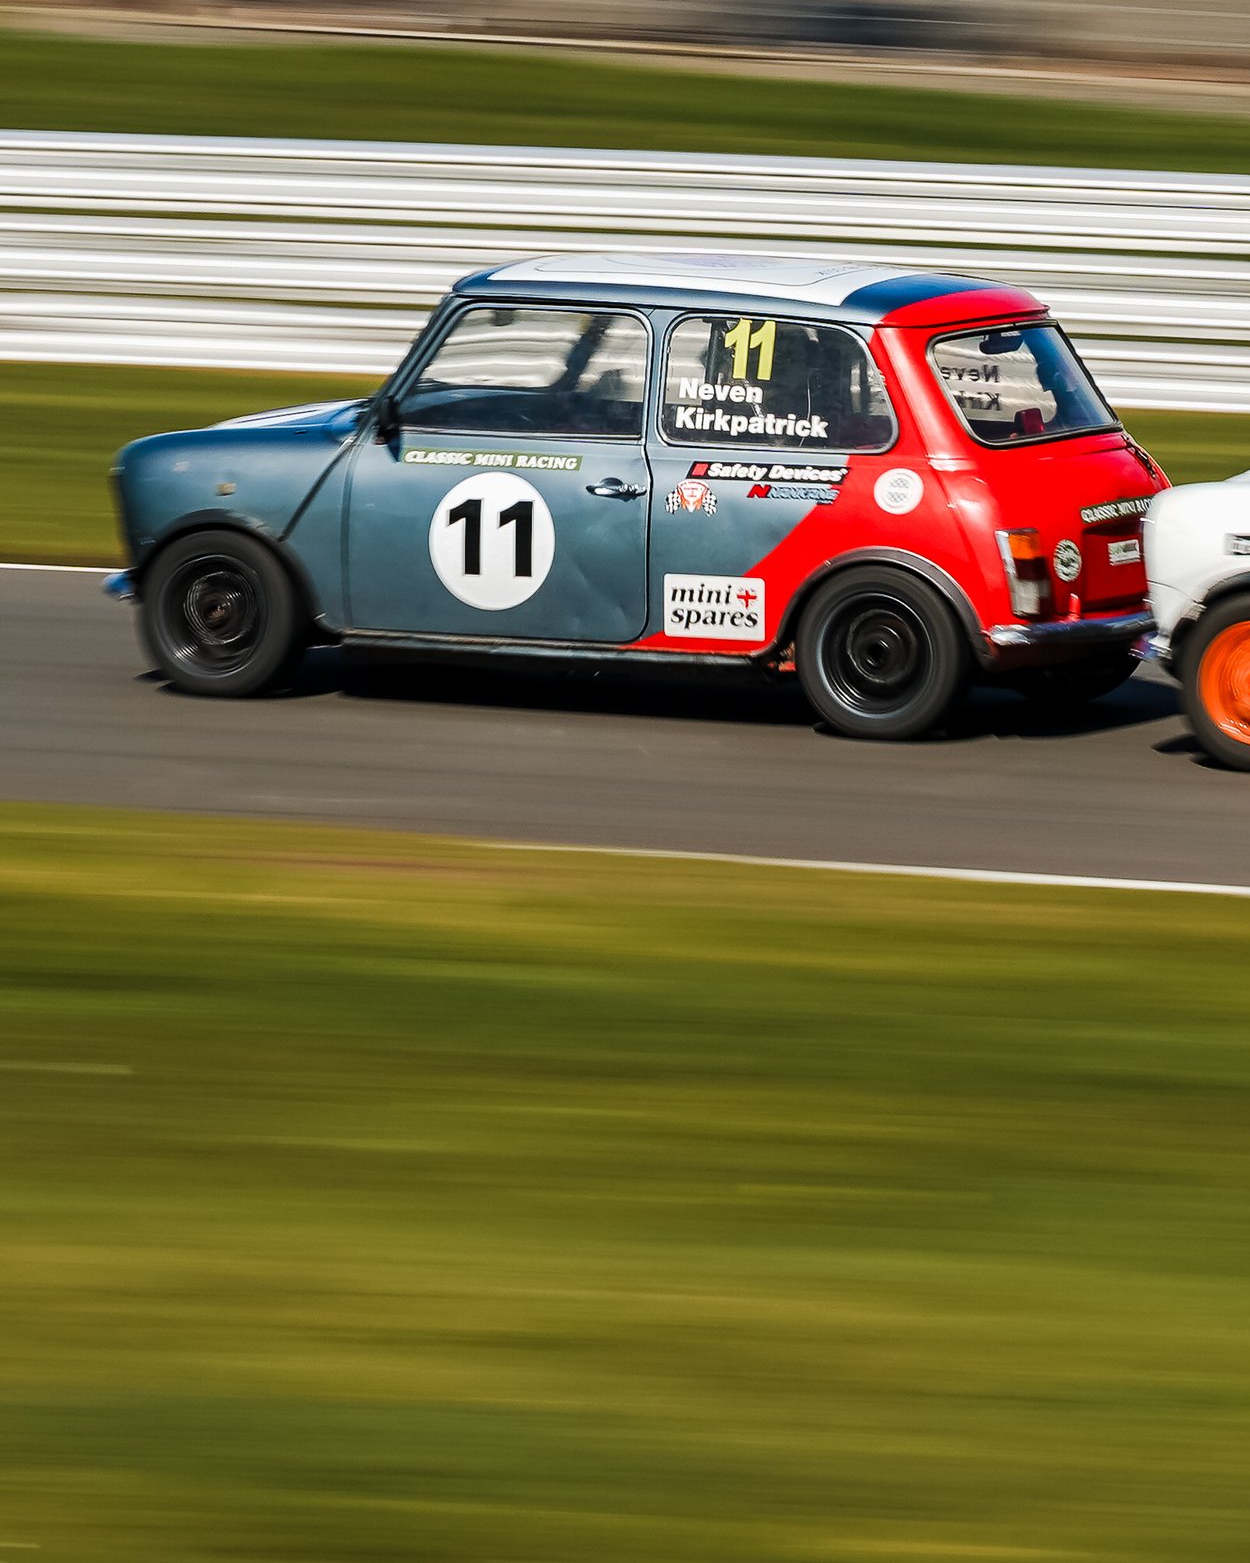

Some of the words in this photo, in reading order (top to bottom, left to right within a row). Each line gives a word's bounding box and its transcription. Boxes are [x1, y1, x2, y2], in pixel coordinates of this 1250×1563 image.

[723, 317, 777, 381] 11
[678, 377, 763, 404] Neven
[675, 406, 829, 438] Kirkpatrick
[404, 450, 473, 465] CLASSIC
[473, 453, 514, 467] MINI
[515, 455, 578, 470] RACING
[708, 463, 767, 481] Safety
[768, 464, 843, 482] Devices
[446, 498, 535, 578] 11
[671, 583, 732, 604] mini
[670, 608, 759, 630] spares
